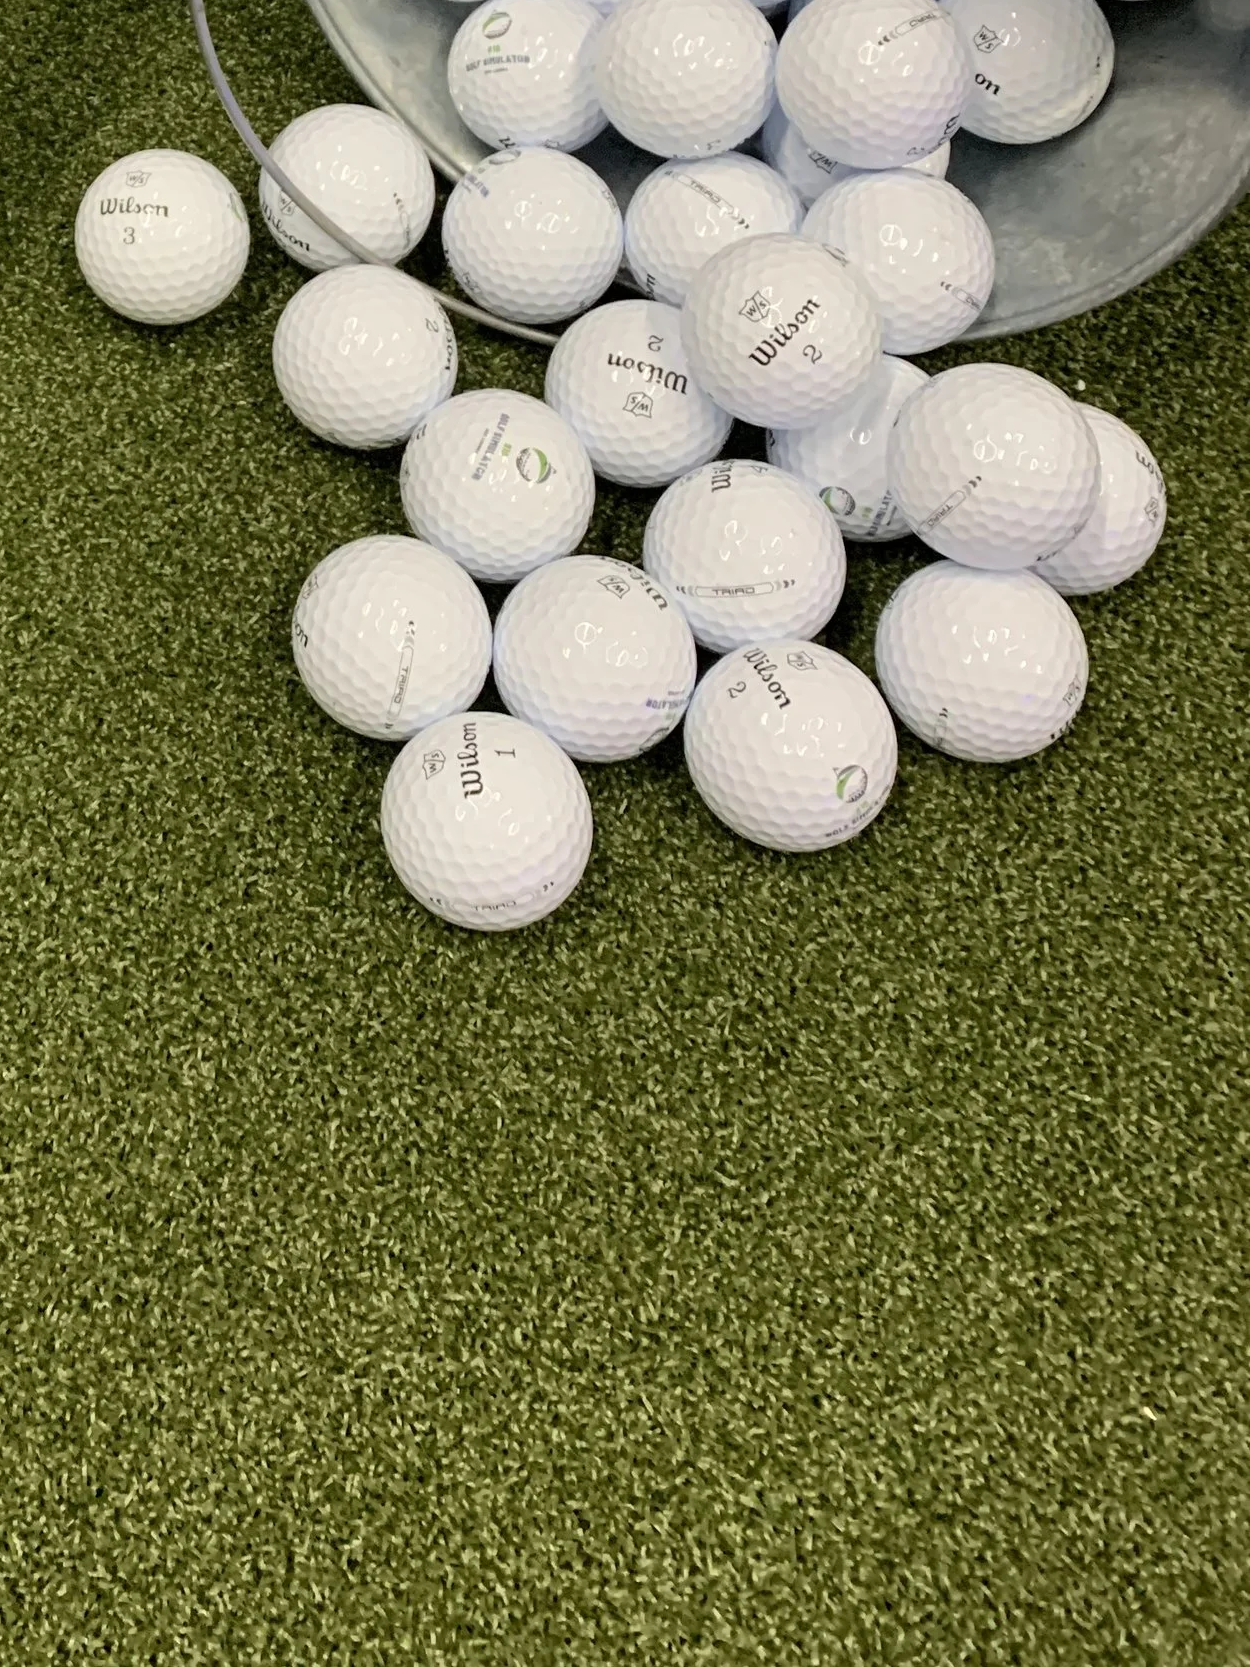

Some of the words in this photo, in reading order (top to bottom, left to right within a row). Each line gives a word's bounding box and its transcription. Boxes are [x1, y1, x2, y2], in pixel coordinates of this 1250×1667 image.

[690, 179, 722, 204] TRIAD
[99, 197, 169, 218] Wilson
[122, 226, 136, 245] 3
[424, 317, 440, 333] 2
[748, 297, 821, 367] Wilson
[647, 334, 664, 353] 2
[802, 344, 823, 365] 2
[607, 352, 689, 396] Wilson
[927, 503, 954, 527] TRIAD
[712, 586, 756, 597] TRIAD
[393, 665, 409, 704] TRIAD
[727, 680, 748, 699] 2
[743, 647, 792, 711] Wilson
[457, 722, 485, 799] Wilson
[494, 748, 517, 759] 1
